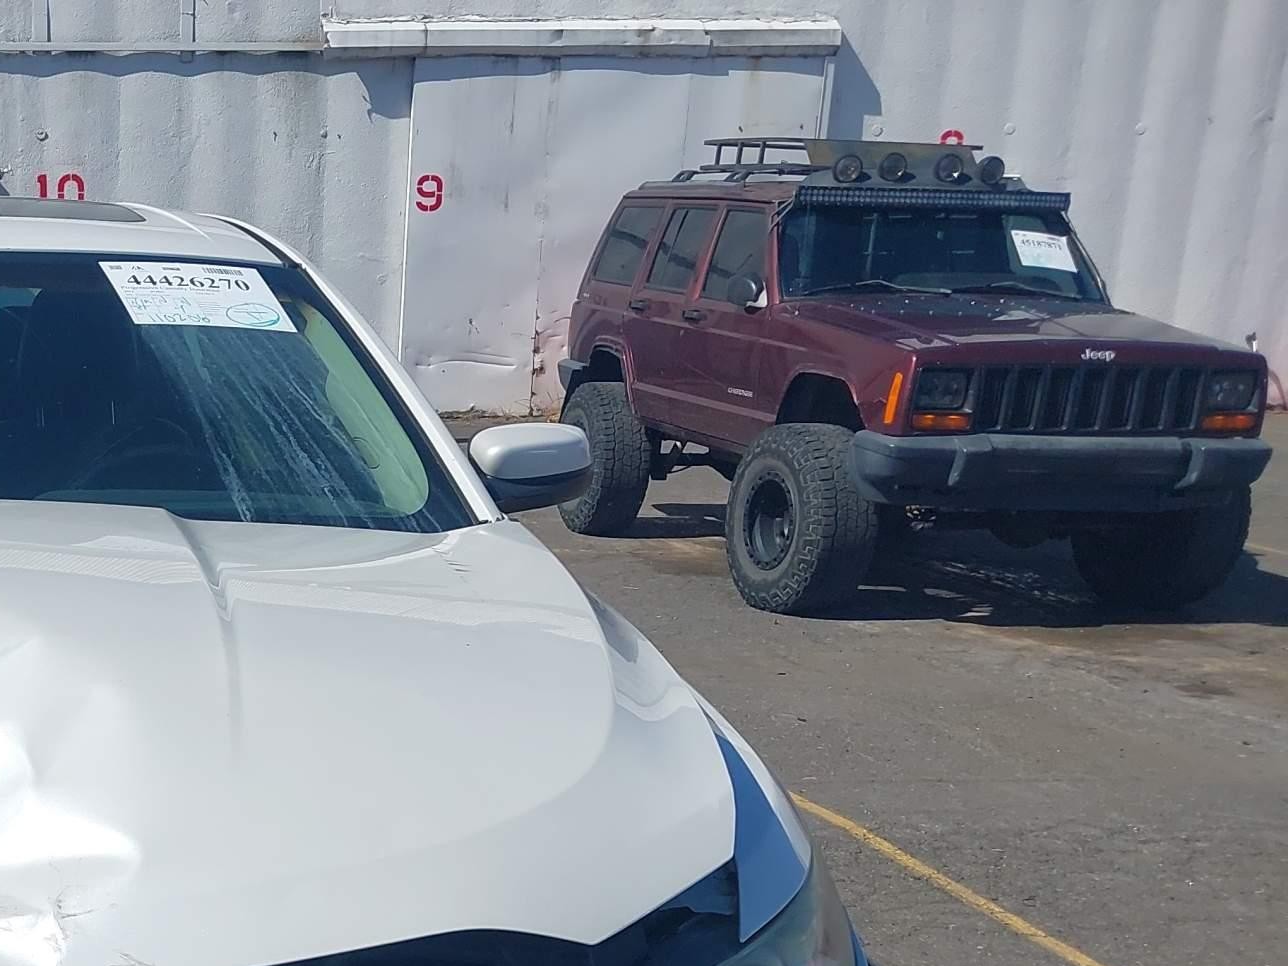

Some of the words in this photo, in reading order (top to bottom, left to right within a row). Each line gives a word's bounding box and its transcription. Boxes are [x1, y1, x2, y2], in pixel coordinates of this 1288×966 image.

[416, 174, 443, 212] 9
[126, 273, 251, 292] 44426270
[1080, 348, 1116, 362] Jeep
